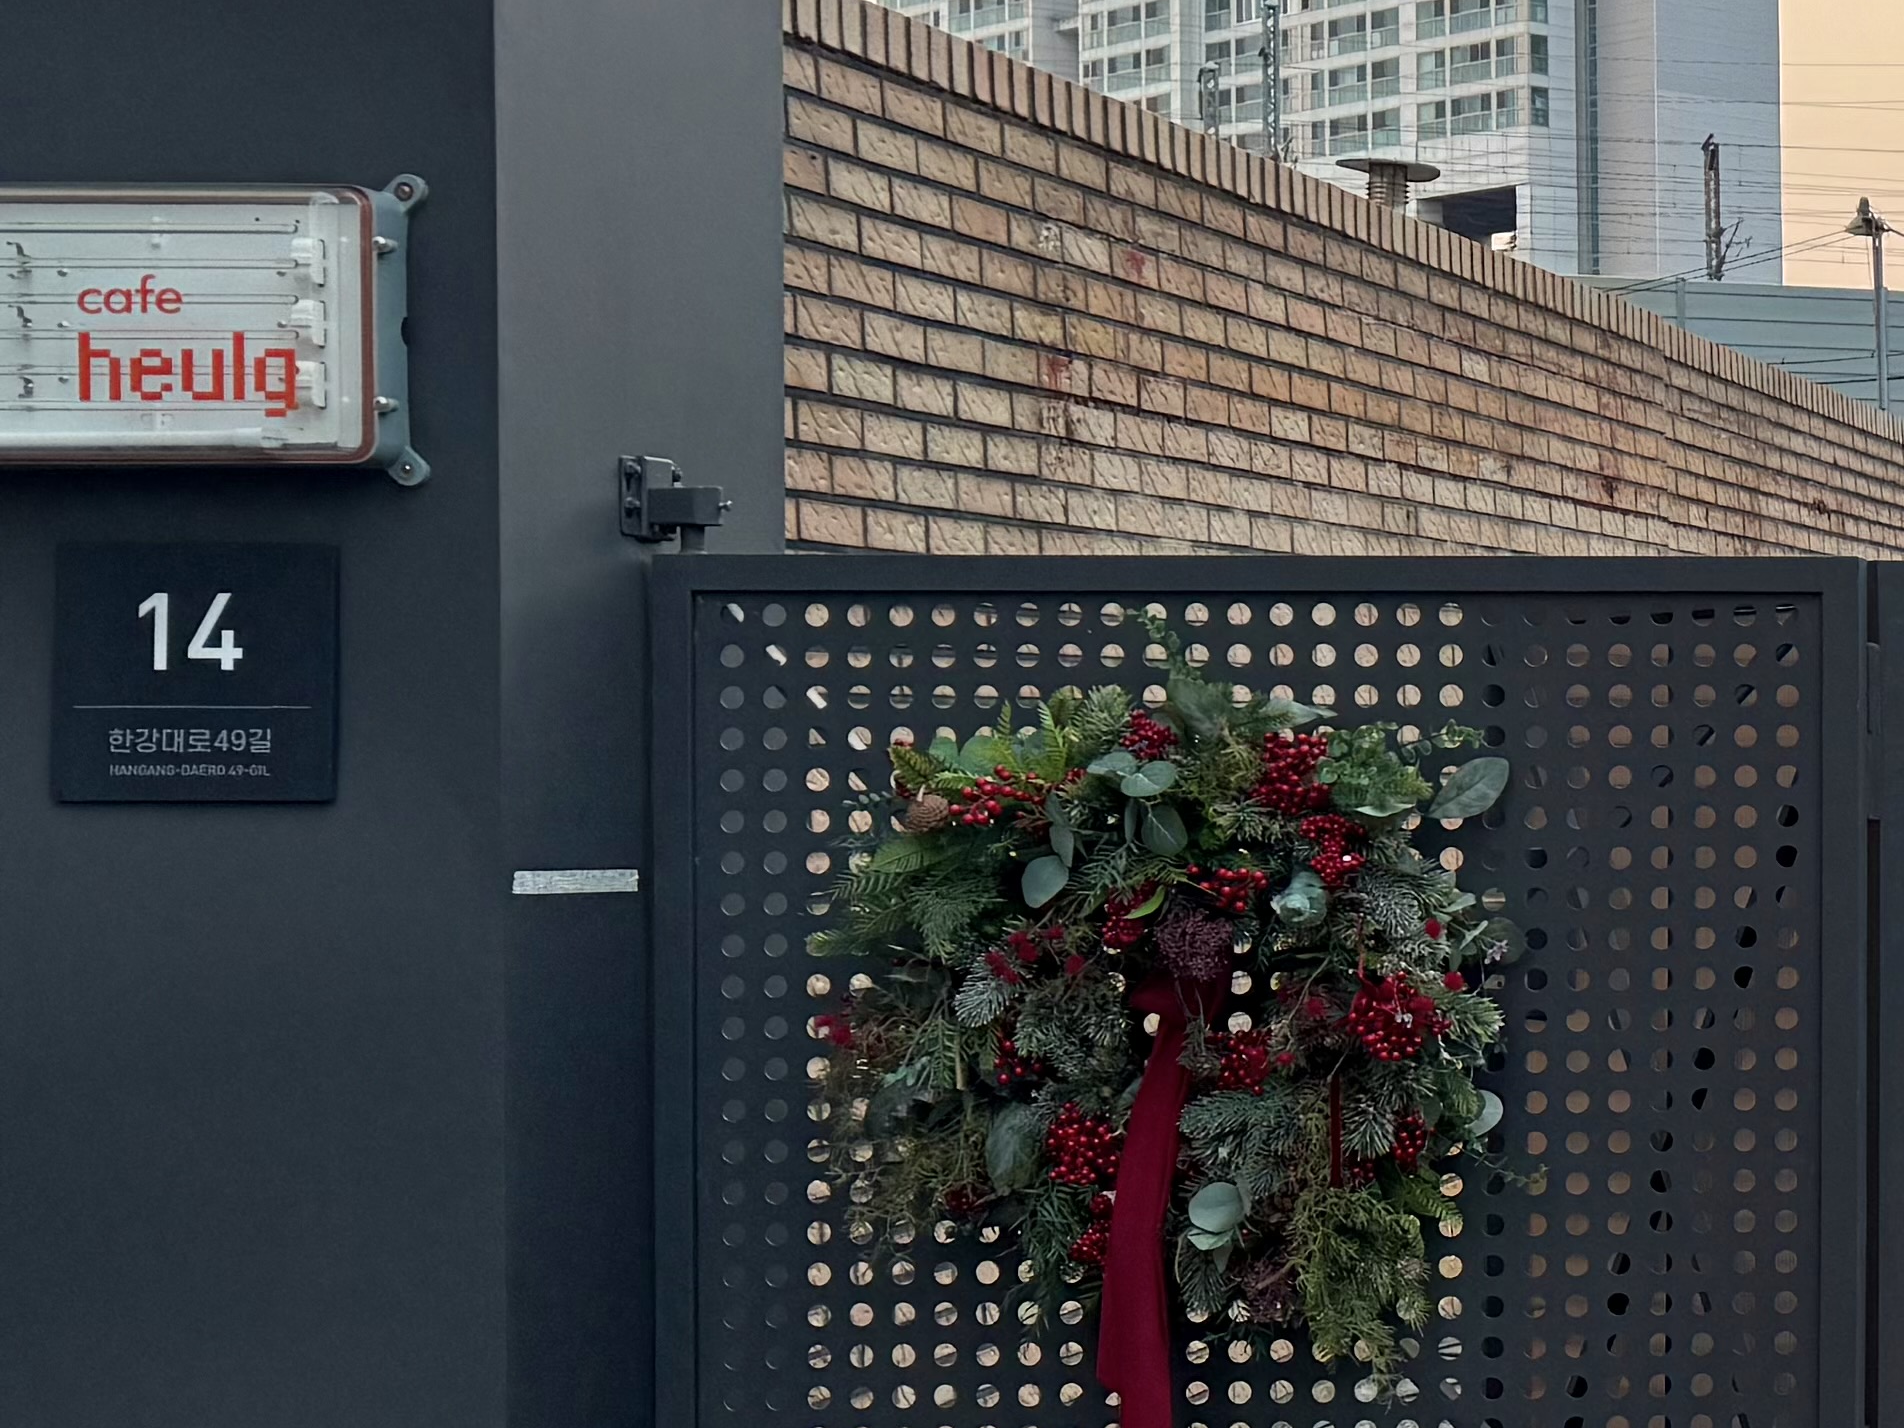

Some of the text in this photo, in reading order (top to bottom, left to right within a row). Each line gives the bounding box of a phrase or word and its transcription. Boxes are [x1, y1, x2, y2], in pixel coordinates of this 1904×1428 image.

[77, 274, 183, 314] cafe
[78, 331, 298, 418] heulg
[138, 592, 243, 672] 14
[108, 728, 271, 753] 한강대로49길
[109, 764, 225, 776] HANGANG-DAERO
